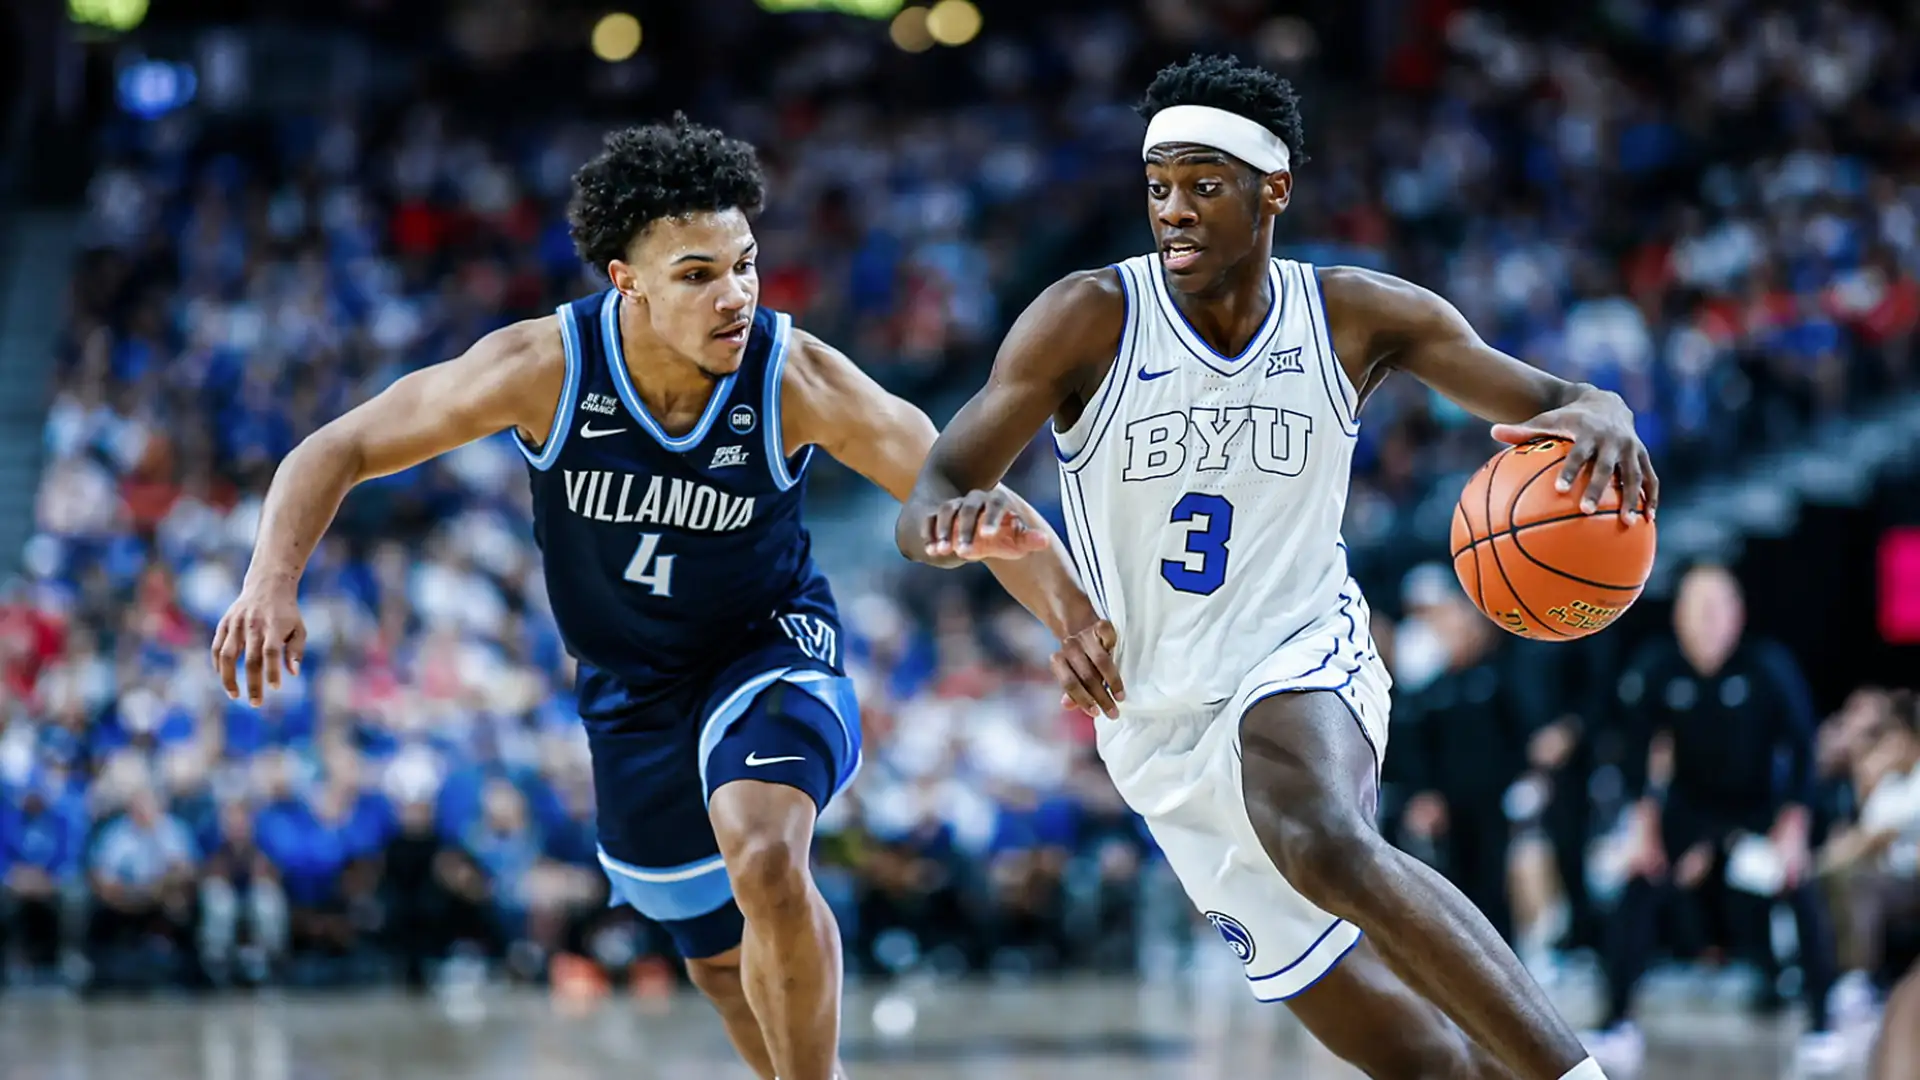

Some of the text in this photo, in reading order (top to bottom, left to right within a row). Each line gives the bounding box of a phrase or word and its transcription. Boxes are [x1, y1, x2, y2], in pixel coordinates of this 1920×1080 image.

[586, 392, 617, 407] BE THE
[580, 400, 617, 416] CHANGE
[732, 413, 751, 426] GHR
[715, 445, 743, 456] BIG
[1122, 405, 1312, 482] BYU
[711, 452, 750, 465] EAST
[563, 469, 755, 532] VILLANOVA
[1160, 492, 1234, 596] 3
[623, 532, 677, 597] 4
